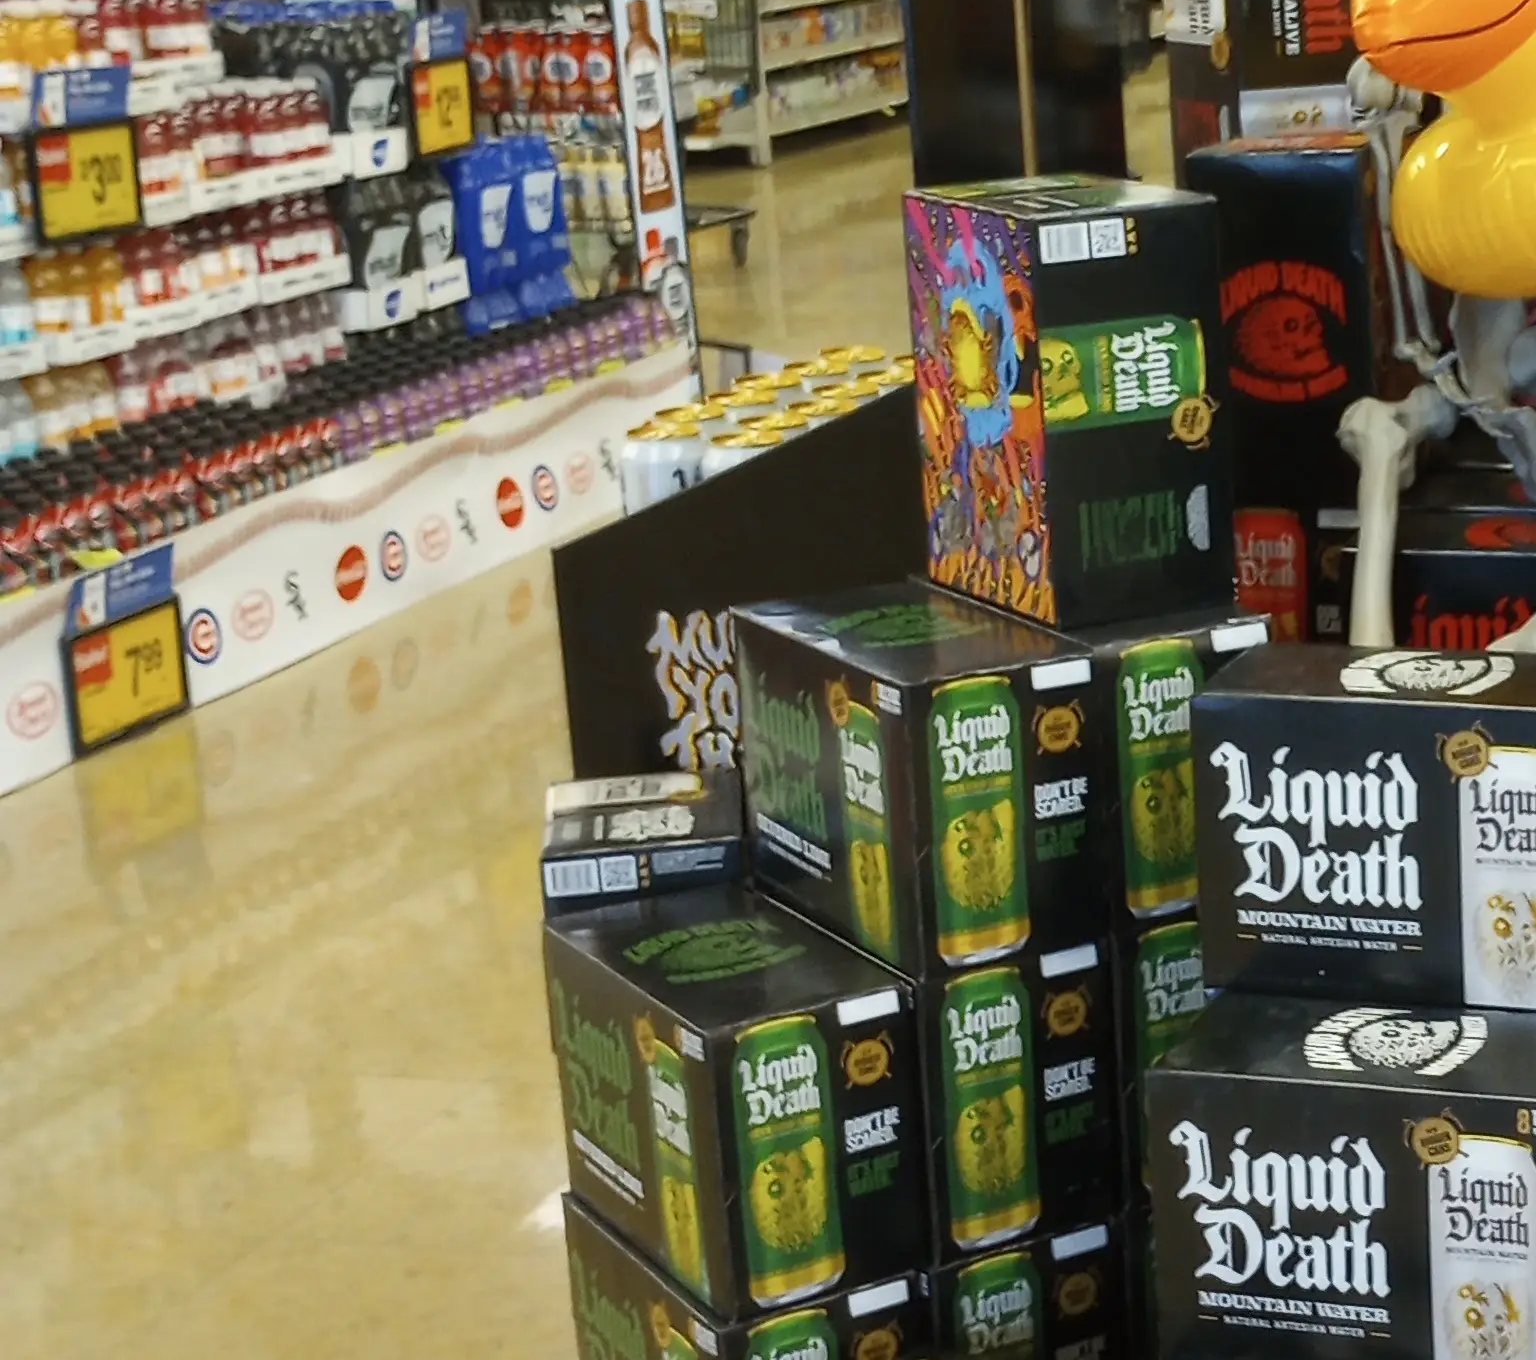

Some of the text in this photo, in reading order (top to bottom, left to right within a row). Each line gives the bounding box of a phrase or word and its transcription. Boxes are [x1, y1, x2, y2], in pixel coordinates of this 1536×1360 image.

[1111, 330, 1145, 415] Death
[1142, 320, 1183, 410] Liquid
[1123, 666, 1195, 712] Liquid
[934, 702, 1012, 750] Liquid
[941, 737, 1013, 782] Death
[1209, 740, 1419, 847] Liquid
[1232, 823, 1423, 912] Death
[1237, 908, 1423, 938] MOUNTAIN WATER
[948, 987, 1022, 1041] Liquid
[738, 1042, 819, 1093] Liquid
[954, 1024, 1024, 1072] Death
[746, 1081, 822, 1129] Death
[1168, 1119, 1387, 1231] Liquid
[1438, 1165, 1529, 1216] Liquid
[1193, 1203, 1391, 1299] Death
[1444, 1205, 1530, 1249] Death
[960, 1279, 1032, 1331] Liquid
[1197, 1289, 1391, 1325] MOUNTAIN WATER
